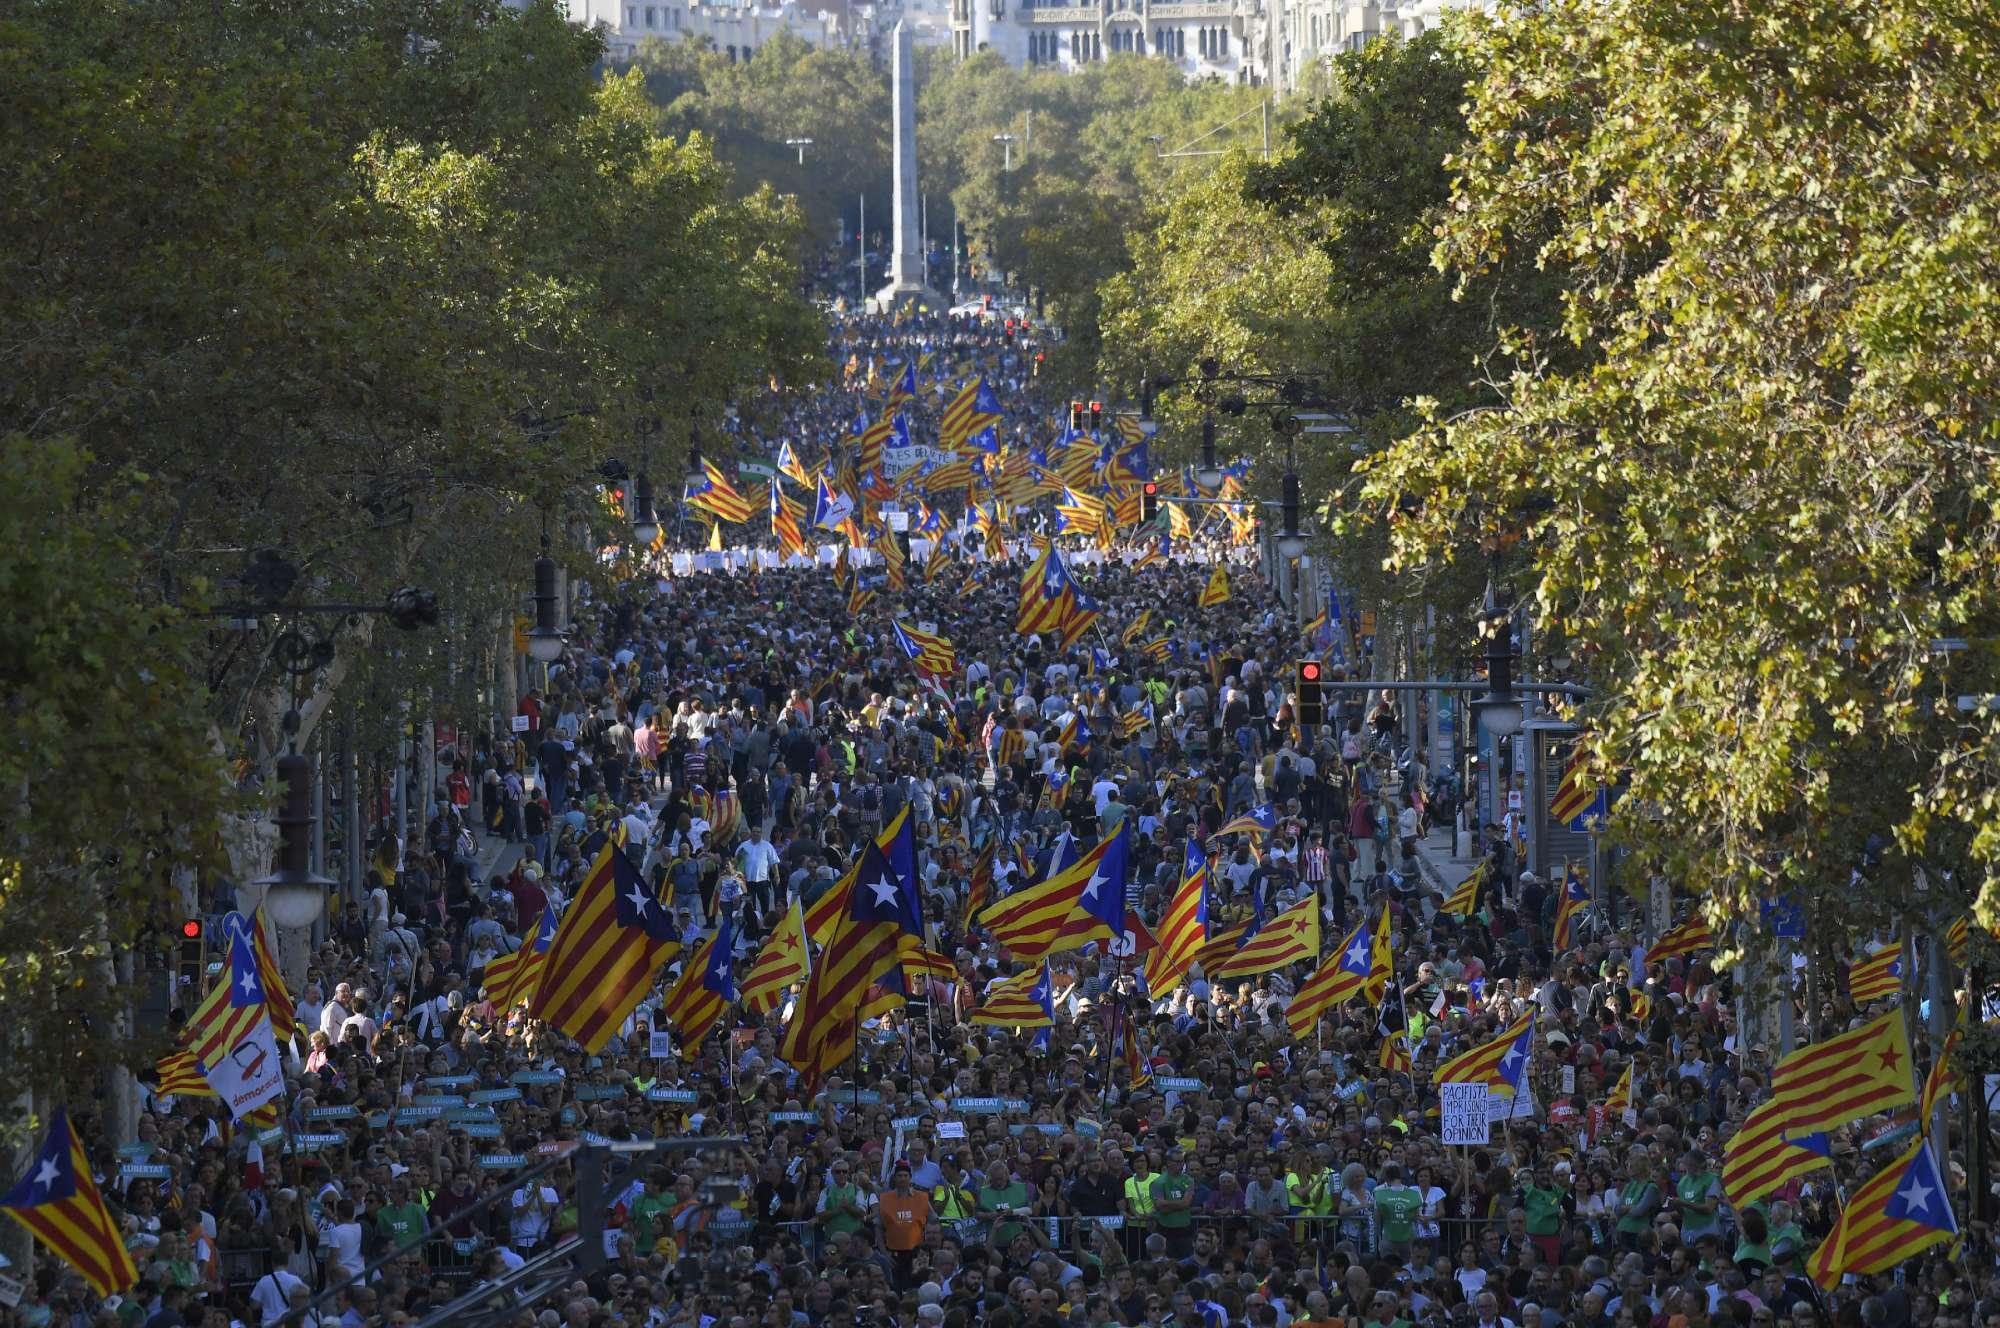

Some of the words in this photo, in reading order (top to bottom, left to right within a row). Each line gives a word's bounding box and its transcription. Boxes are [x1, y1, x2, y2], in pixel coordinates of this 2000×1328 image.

[1159, 1077, 1199, 1087] LLIBERTAT
[652, 1089, 692, 1099] LLIBERTAT
[1443, 1084, 1488, 1100] PACIFISTS
[957, 1098, 999, 1107] LLIBERTAT
[1443, 1099, 1488, 1113] IMPRISONED
[312, 1106, 351, 1116] LLIBERTAT
[401, 1106, 442, 1116] LLIBERTAT
[774, 1111, 814, 1121] LLIBERTAT
[1443, 1113, 1464, 1128] FOR
[1466, 1113, 1487, 1128] THEIR
[299, 1134, 339, 1143] LLIBERTAT
[1443, 1127, 1485, 1142] OPINION
[538, 1144, 559, 1153] SAVE
[122, 1164, 164, 1174] LLIBERTAT
[708, 1221, 750, 1230] LLIBERTAT
